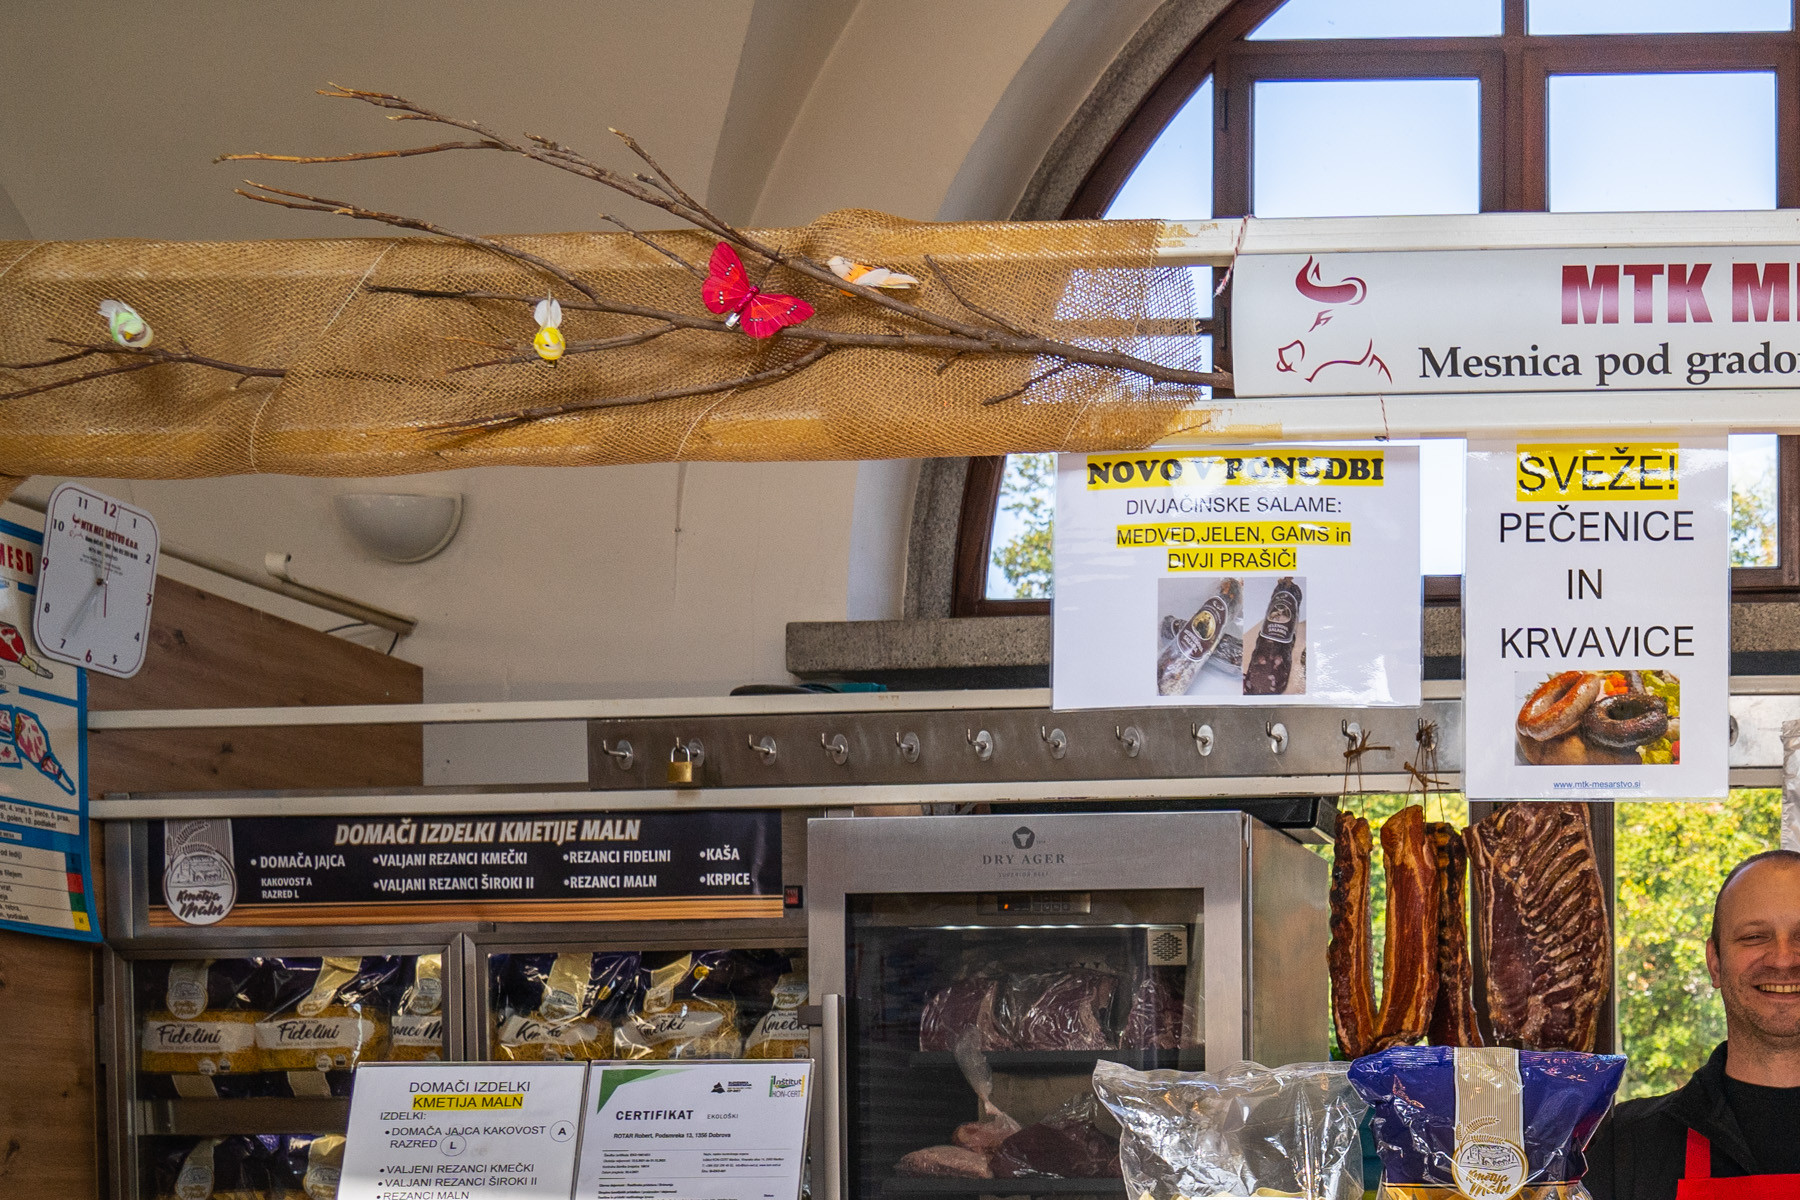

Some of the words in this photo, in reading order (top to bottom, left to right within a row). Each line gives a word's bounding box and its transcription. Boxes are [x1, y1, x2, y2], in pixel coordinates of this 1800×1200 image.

[1561, 264, 1716, 325] MTK
[1419, 344, 1581, 379] Mesnica
[1595, 343, 1680, 386] pod
[1087, 457, 1184, 486] NOVO
[1224, 455, 1385, 482] PONUDBI
[1517, 447, 1678, 493] SVEŽE!
[78, 496, 88, 509] 11
[104, 501, 118, 518] 12
[1126, 493, 1251, 516] DIVJAČINSKE
[1256, 496, 1343, 514] SALAME:
[53, 518, 65, 532] 10
[1499, 504, 1695, 543] PEČENICE
[1271, 525, 1329, 543] GAMS
[1336, 526, 1352, 544] in
[42, 556, 50, 571] 9
[1168, 552, 1214, 570] DIVJI
[1221, 548, 1297, 569] PRAŠIČ!
[1567, 568, 1604, 600] IN
[1500, 624, 1696, 660] KRVAVICE
[85, 649, 93, 663] 6
[1552, 779, 1642, 791] www.mtk-mesarstvo.si
[335, 818, 416, 845] DOMAČI
[420, 821, 497, 845] IZDELKI
[500, 819, 578, 846] KMETIJE
[580, 818, 642, 842] MALN
[379, 853, 426, 870] VALJANI
[429, 851, 478, 867] REZANCI
[481, 848, 528, 865] KMEČKI
[569, 850, 621, 864] REZANCI
[623, 849, 671, 864] FIDELINI
[706, 844, 740, 861] KAŠA
[982, 854, 1014, 865] DRY
[1021, 853, 1065, 865] AGER
[260, 852, 313, 869] DOMAČA
[314, 854, 346, 871] JAJCA
[261, 877, 305, 887] KAKOVOST
[379, 877, 426, 893] VALJANI
[429, 876, 478, 891] REZANCI
[481, 873, 525, 890] ŠIROKI
[525, 876, 534, 889] II
[569, 874, 621, 889] REZANCI
[623, 874, 657, 888] MALN
[706, 872, 750, 887] KRPICE
[262, 889, 293, 899] RAZRED
[156, 1023, 221, 1045] Fidelini
[277, 1021, 340, 1041] Fidelini
[409, 1080, 469, 1094] DOMAČI
[474, 1081, 531, 1093] IZDELKI
[412, 1096, 477, 1108] KMETIJA
[481, 1096, 523, 1107] MALN
[380, 1112, 427, 1121] IZDELKI:
[616, 1109, 695, 1121] CERTIFIKAT
[391, 1125, 442, 1137] DOMAČA
[444, 1126, 481, 1136] JAJCA
[483, 1125, 546, 1135] KAKOVOST
[558, 1127, 567, 1136] A
[389, 1138, 438, 1149] RAZRED
[386, 1164, 434, 1175] VALJENI
[436, 1163, 487, 1173] REZANCI
[490, 1161, 535, 1173] KMEČKI
[384, 1178, 432, 1188] VALJANI
[434, 1176, 486, 1188] REZANCI
[488, 1174, 529, 1187] ŠIROKI
[382, 1191, 434, 1200] REZANCI
[437, 1190, 470, 1200] MALN
